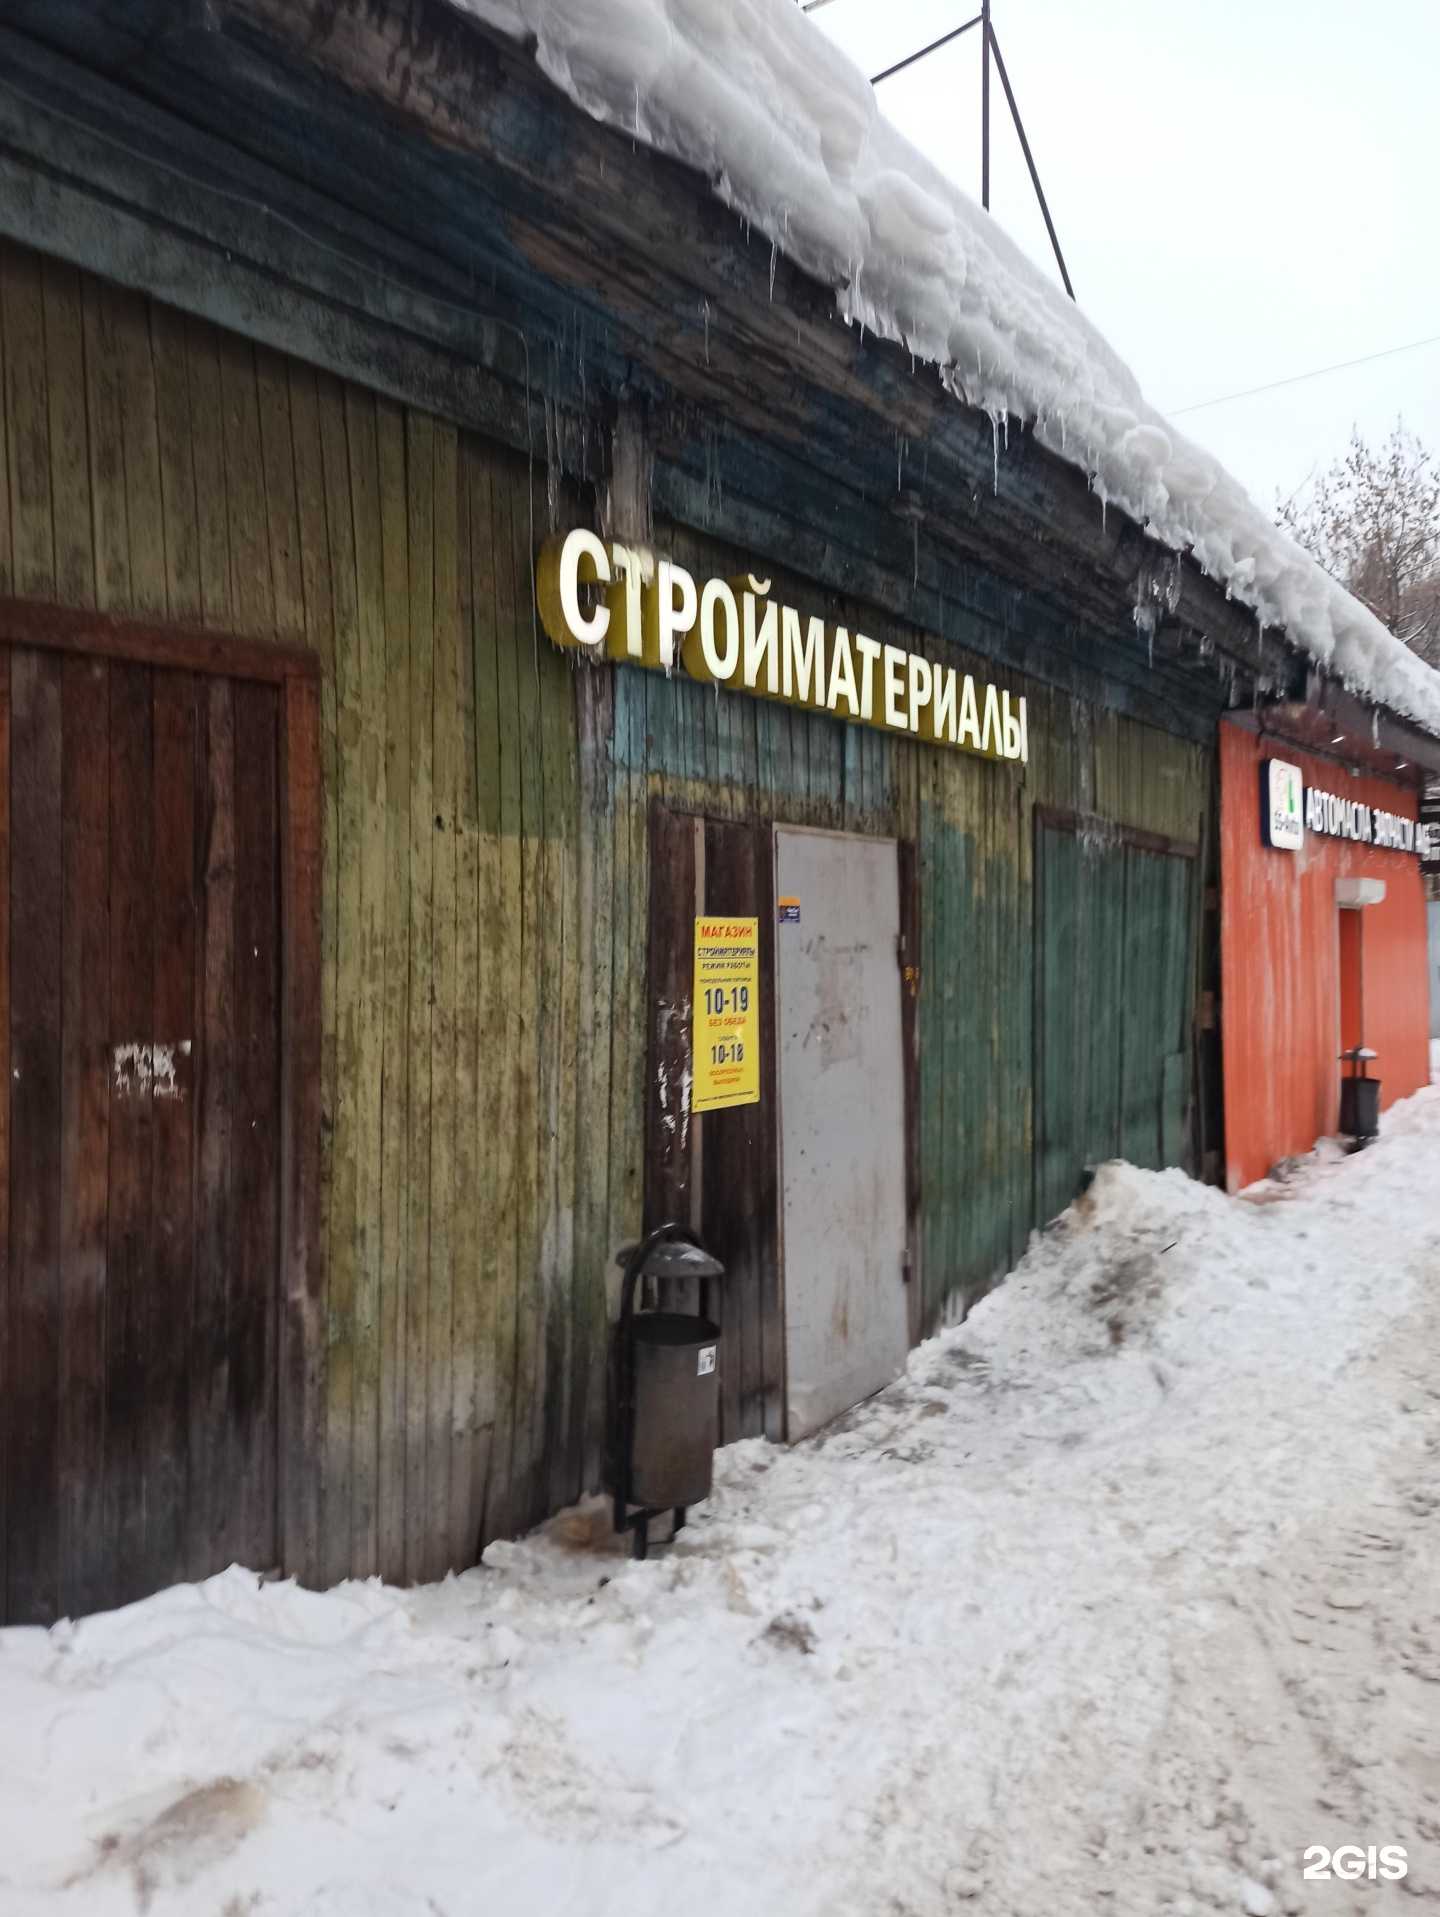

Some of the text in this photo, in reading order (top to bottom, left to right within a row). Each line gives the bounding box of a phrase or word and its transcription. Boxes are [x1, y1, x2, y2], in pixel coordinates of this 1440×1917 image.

[560, 528, 1028, 764] СТРОЙМАТЕРИАЛЫ
[1306, 787, 1371, 842] АВТОМАСЛА
[701, 925, 753, 938] МАГАЗИН
[704, 986, 750, 1015] 10-19
[711, 1044, 744, 1065] 10-18
